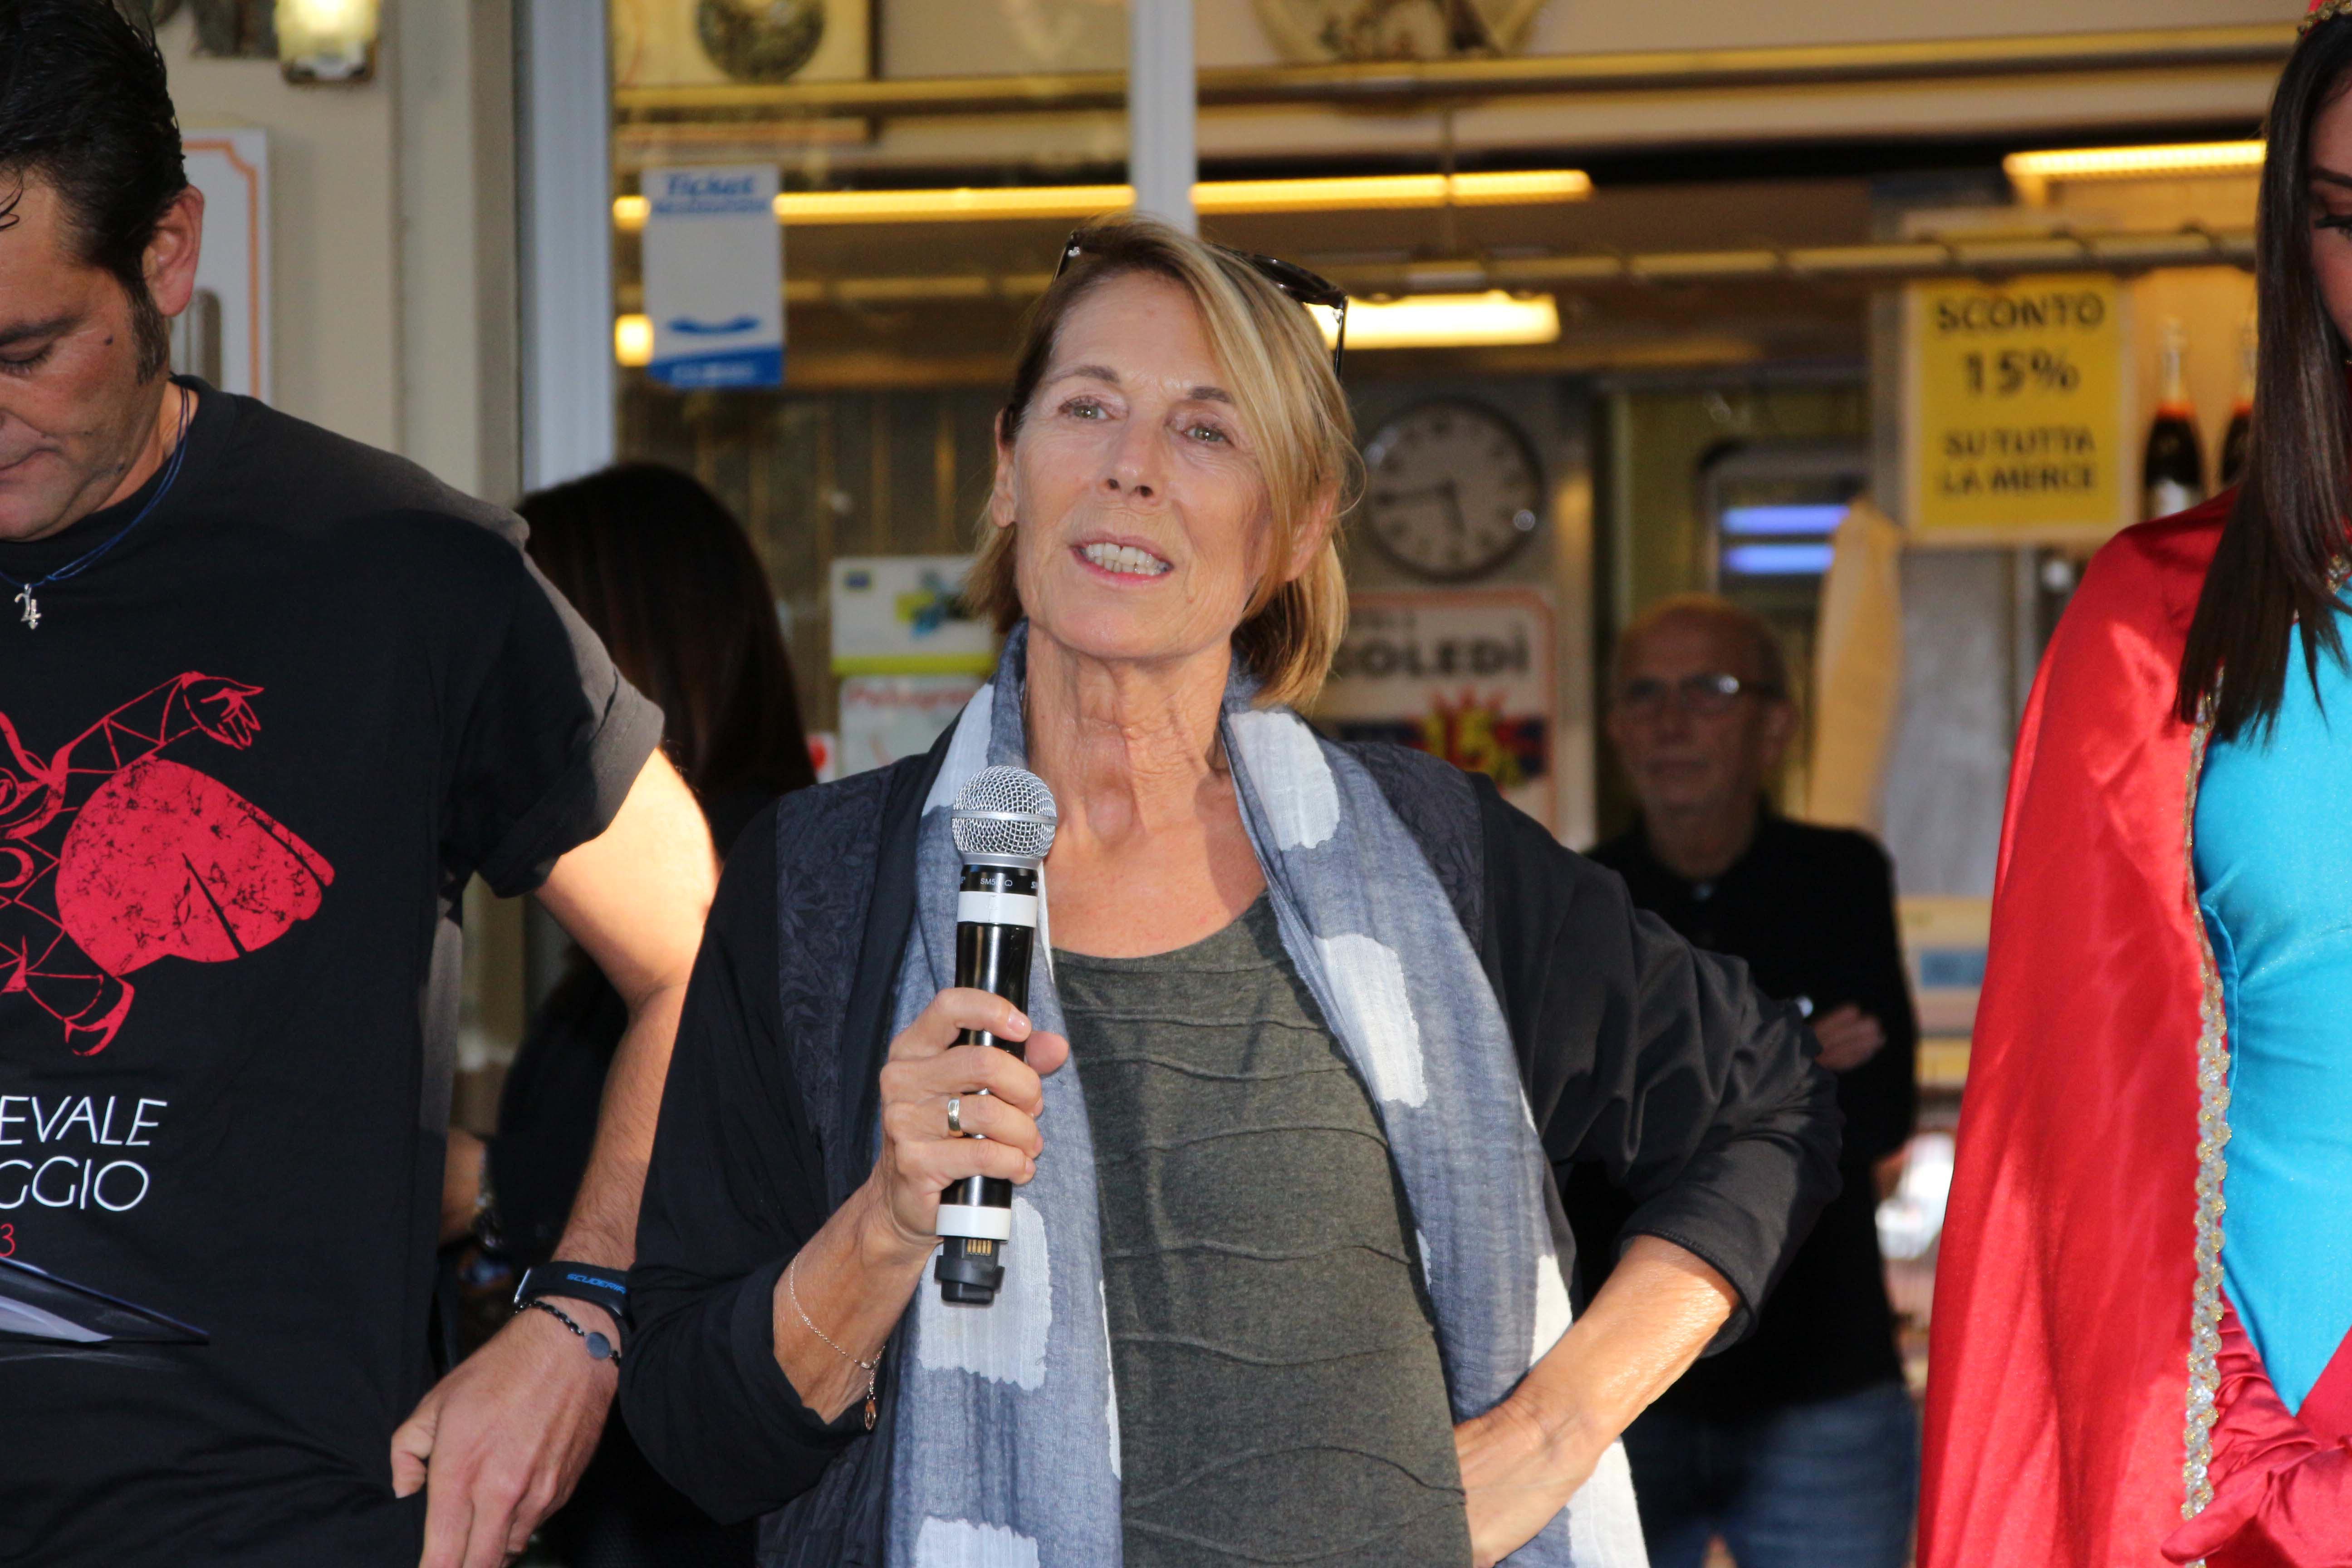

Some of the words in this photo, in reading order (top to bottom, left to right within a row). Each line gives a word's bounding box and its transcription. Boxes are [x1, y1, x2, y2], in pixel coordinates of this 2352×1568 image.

[1936, 292, 2106, 333] SCONTO
[1965, 348, 2081, 397] 15%
[1945, 428, 1986, 458] SU
[1994, 425, 2097, 456] TUTTA
[1941, 466, 1981, 495] LA
[1991, 461, 2097, 493] MERCE
[0, 1095, 168, 1146] EVALE
[567, 1274, 627, 1295] SCUDERIA
